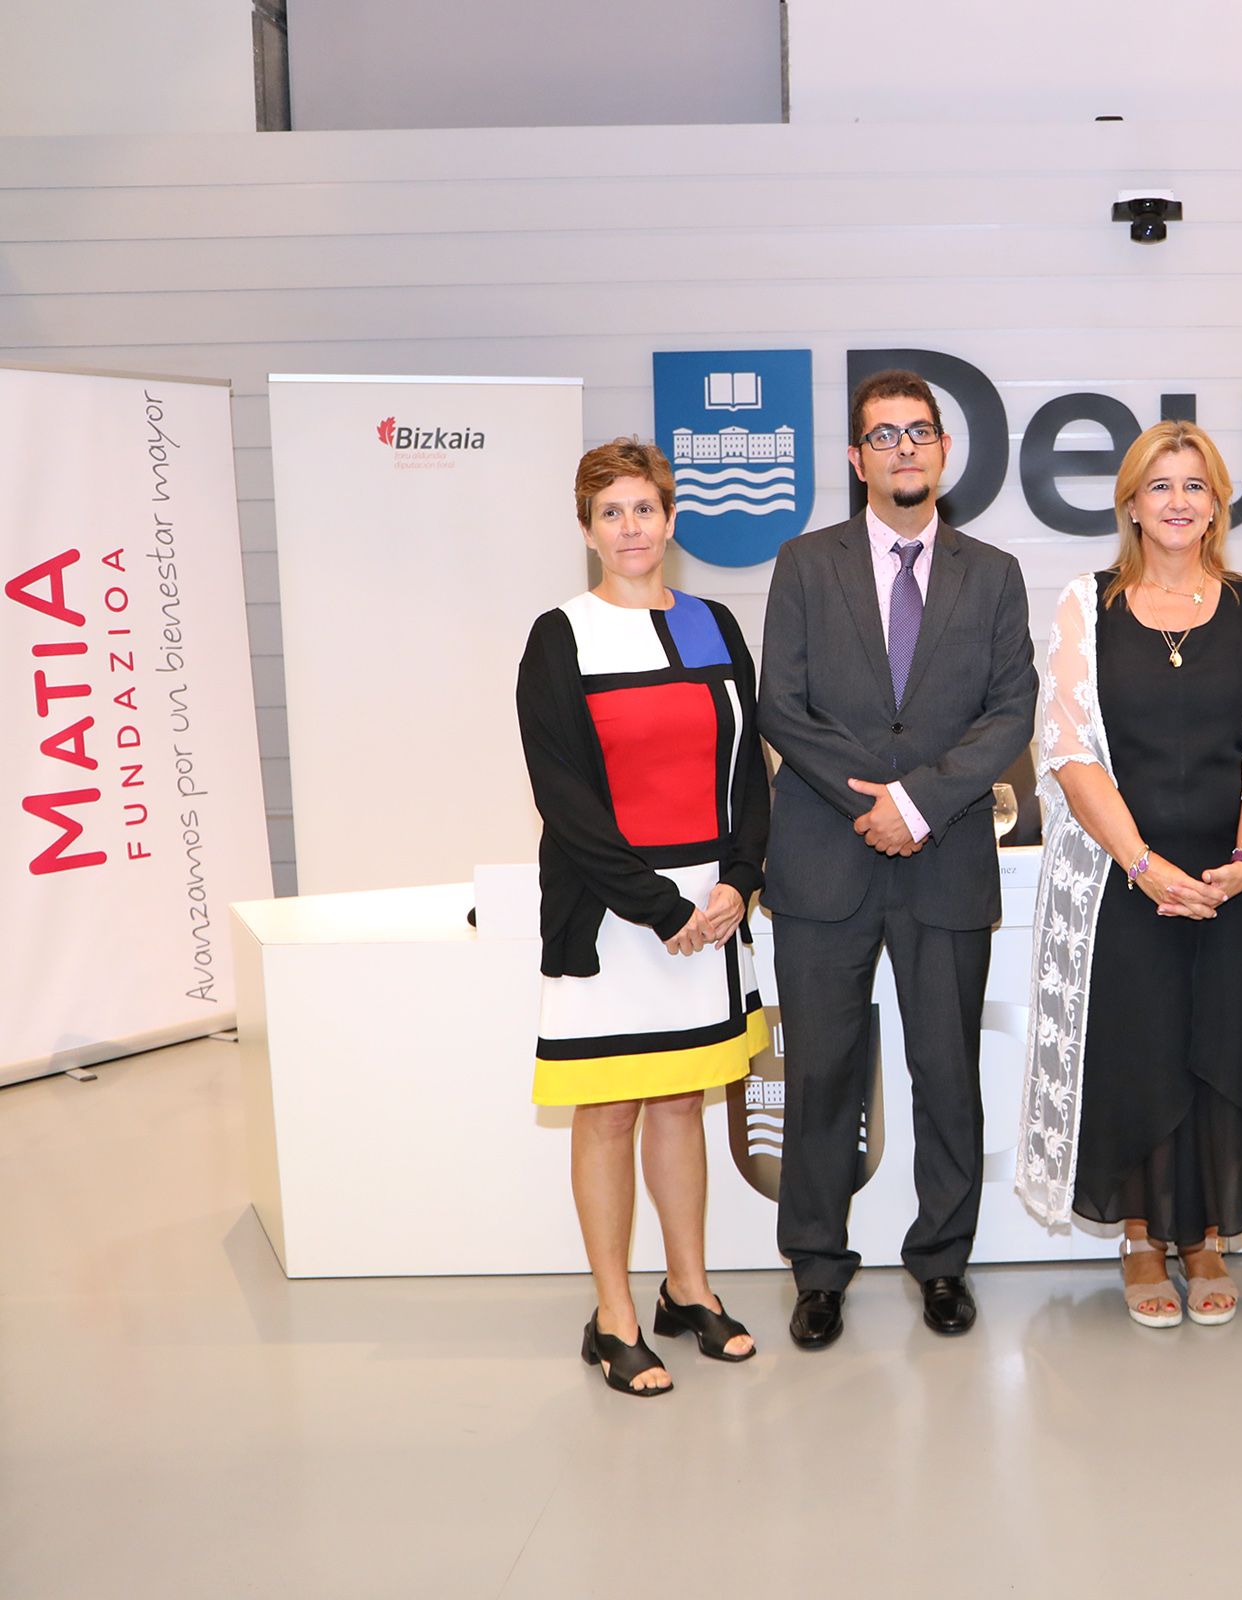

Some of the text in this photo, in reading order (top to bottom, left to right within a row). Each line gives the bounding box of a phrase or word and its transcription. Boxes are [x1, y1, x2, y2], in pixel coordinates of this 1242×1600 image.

[395, 427, 485, 449] Bizkaia
[4, 549, 107, 875] MATIA
[102, 549, 151, 860] FUNDAZIOA
[144, 389, 218, 1003] Avanzamos por un bienestar mayor
